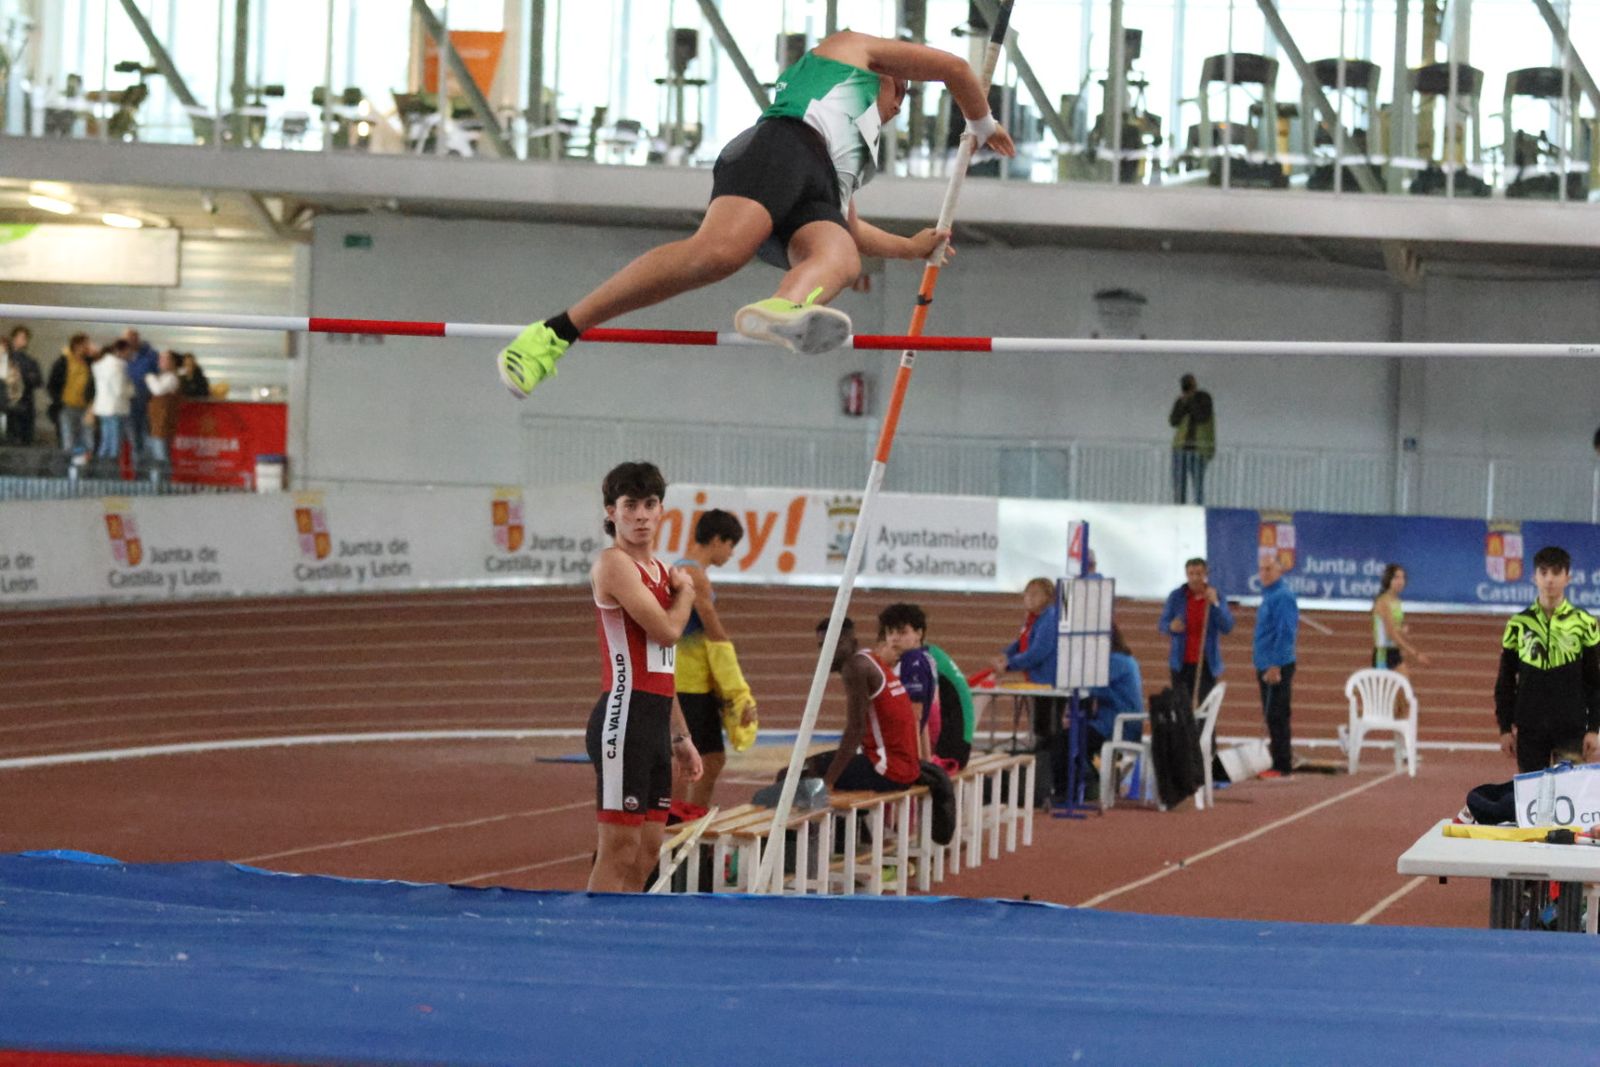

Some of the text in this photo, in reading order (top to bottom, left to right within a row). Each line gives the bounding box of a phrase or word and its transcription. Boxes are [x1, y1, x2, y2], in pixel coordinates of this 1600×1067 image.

[876, 525, 998, 550] Ayuntamiento
[876, 552, 996, 577] de Salamanca
[1304, 556, 1357, 575] Junta
[1322, 580, 1334, 599] y
[607, 653, 626, 759] C.A. VALLADOLID
